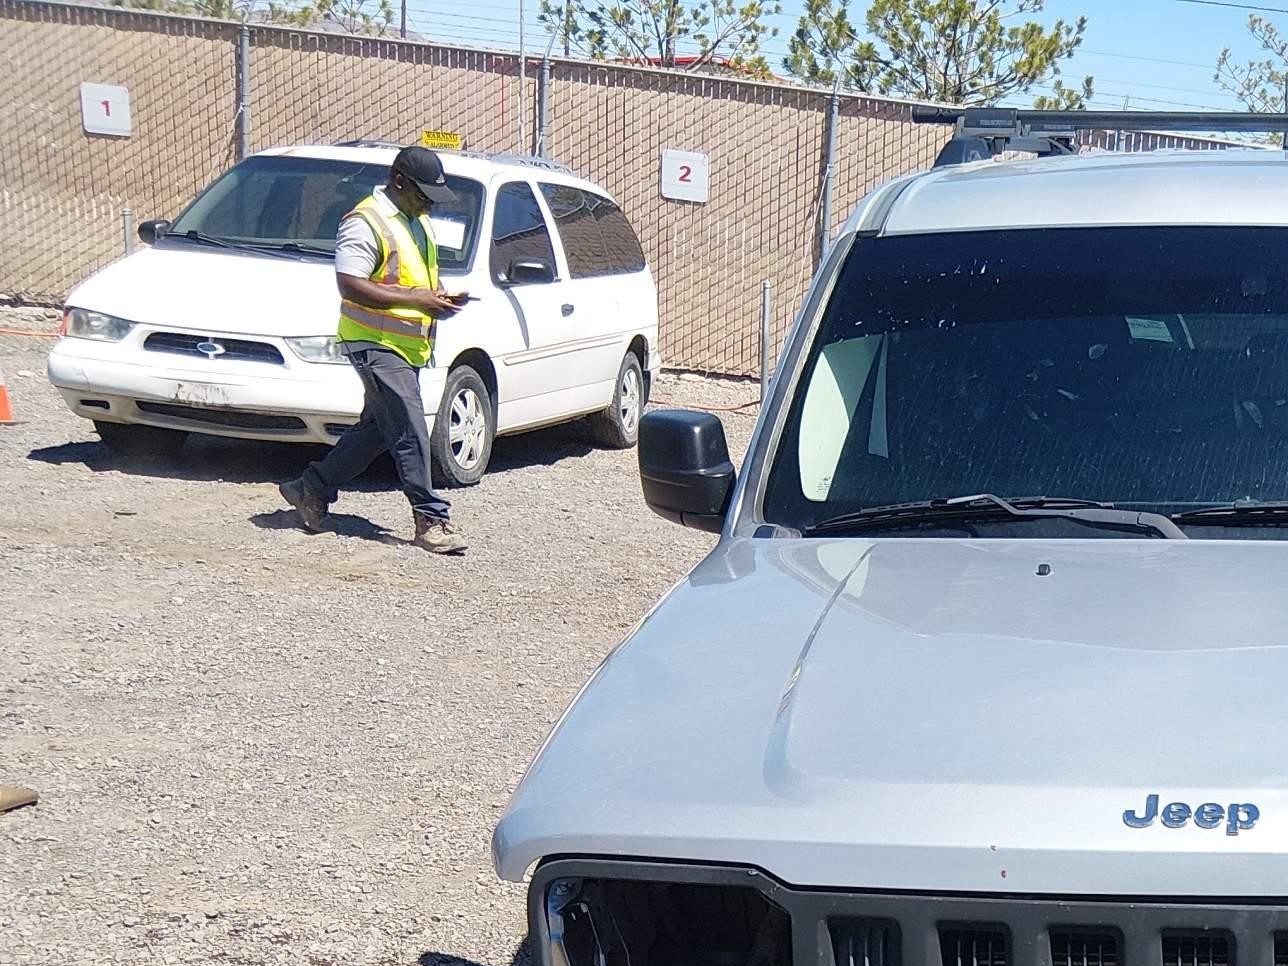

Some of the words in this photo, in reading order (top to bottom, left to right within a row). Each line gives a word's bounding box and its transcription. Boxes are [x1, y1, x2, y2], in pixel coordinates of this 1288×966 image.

[101, 100, 111, 116] 1
[678, 165, 692, 183] 2
[1123, 794, 1260, 836] Jeep
